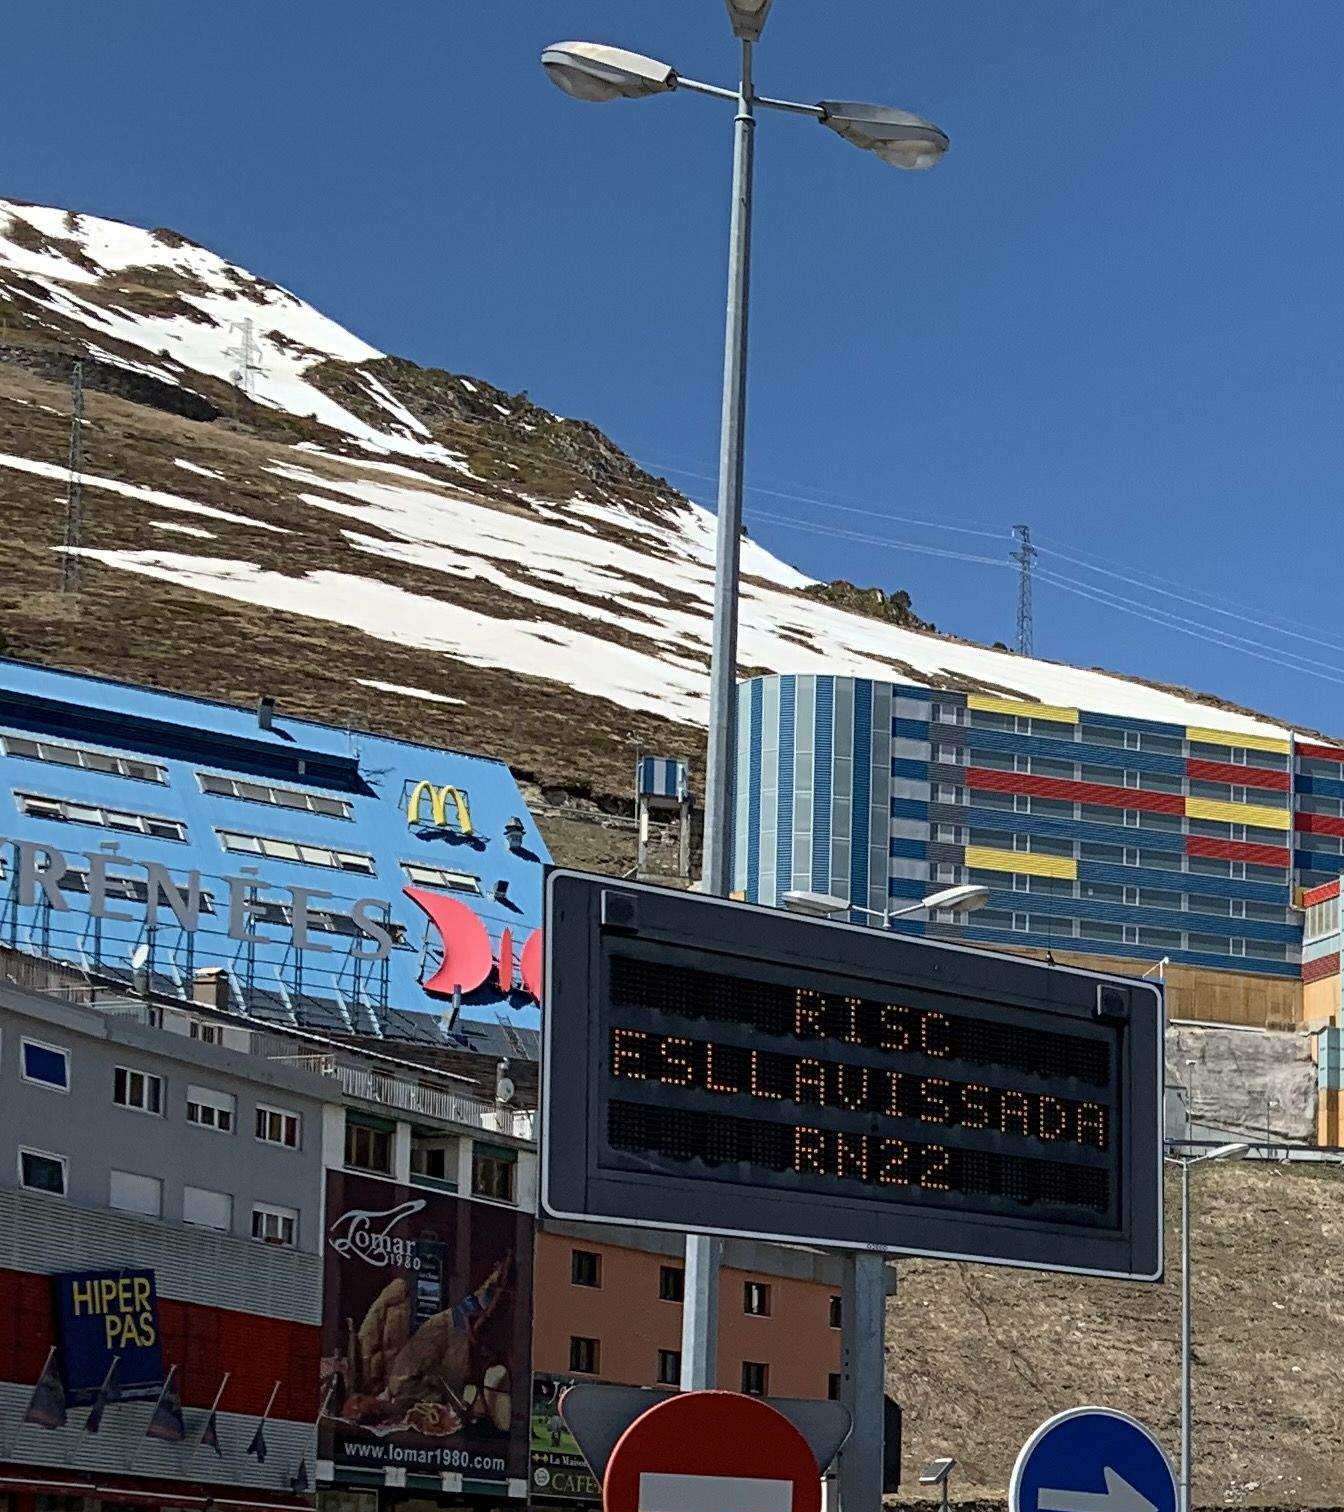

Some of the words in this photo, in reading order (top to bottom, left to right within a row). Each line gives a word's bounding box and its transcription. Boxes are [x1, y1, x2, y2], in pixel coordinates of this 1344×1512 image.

[795, 986, 952, 1058] RISC
[611, 1027, 1105, 1147] ESLLAVISSADA
[794, 1125, 951, 1191] RN22
[390, 1253, 421, 1271] 1980
[72, 1276, 151, 1316] HIPER
[105, 1312, 156, 1350] PAS
[344, 1440, 506, 1472] www.lomar1980.com
